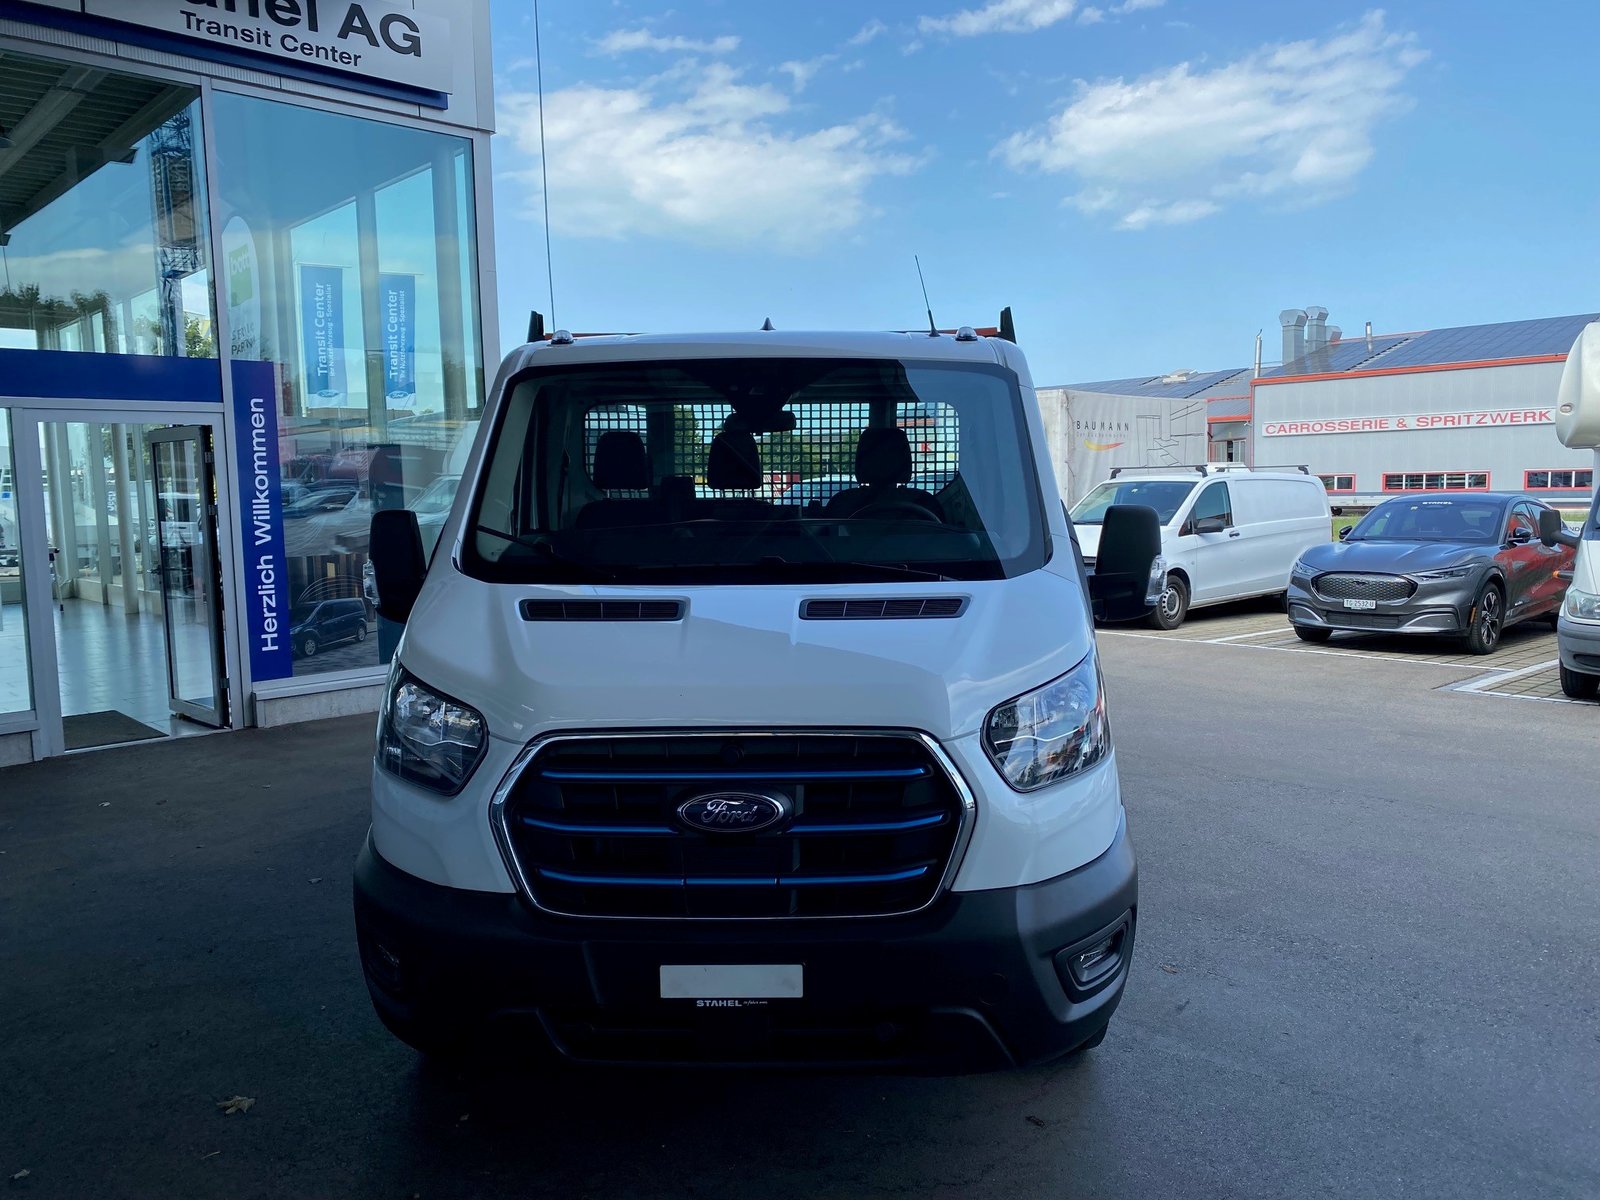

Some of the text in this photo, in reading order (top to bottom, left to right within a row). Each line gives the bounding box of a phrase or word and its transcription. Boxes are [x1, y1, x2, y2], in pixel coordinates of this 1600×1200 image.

[179, 9, 362, 68] Transit Center
[337, 3, 422, 58] AG
[314, 283, 328, 377] Transit Center
[387, 290, 398, 379] Transit Center
[1076, 420, 1129, 431] BAUMANN
[1264, 410, 1552, 435] CARROSSERIE & SPRITZWERK
[250, 398, 279, 651] Herzlich Willkommen
[700, 799, 758, 823] Ford
